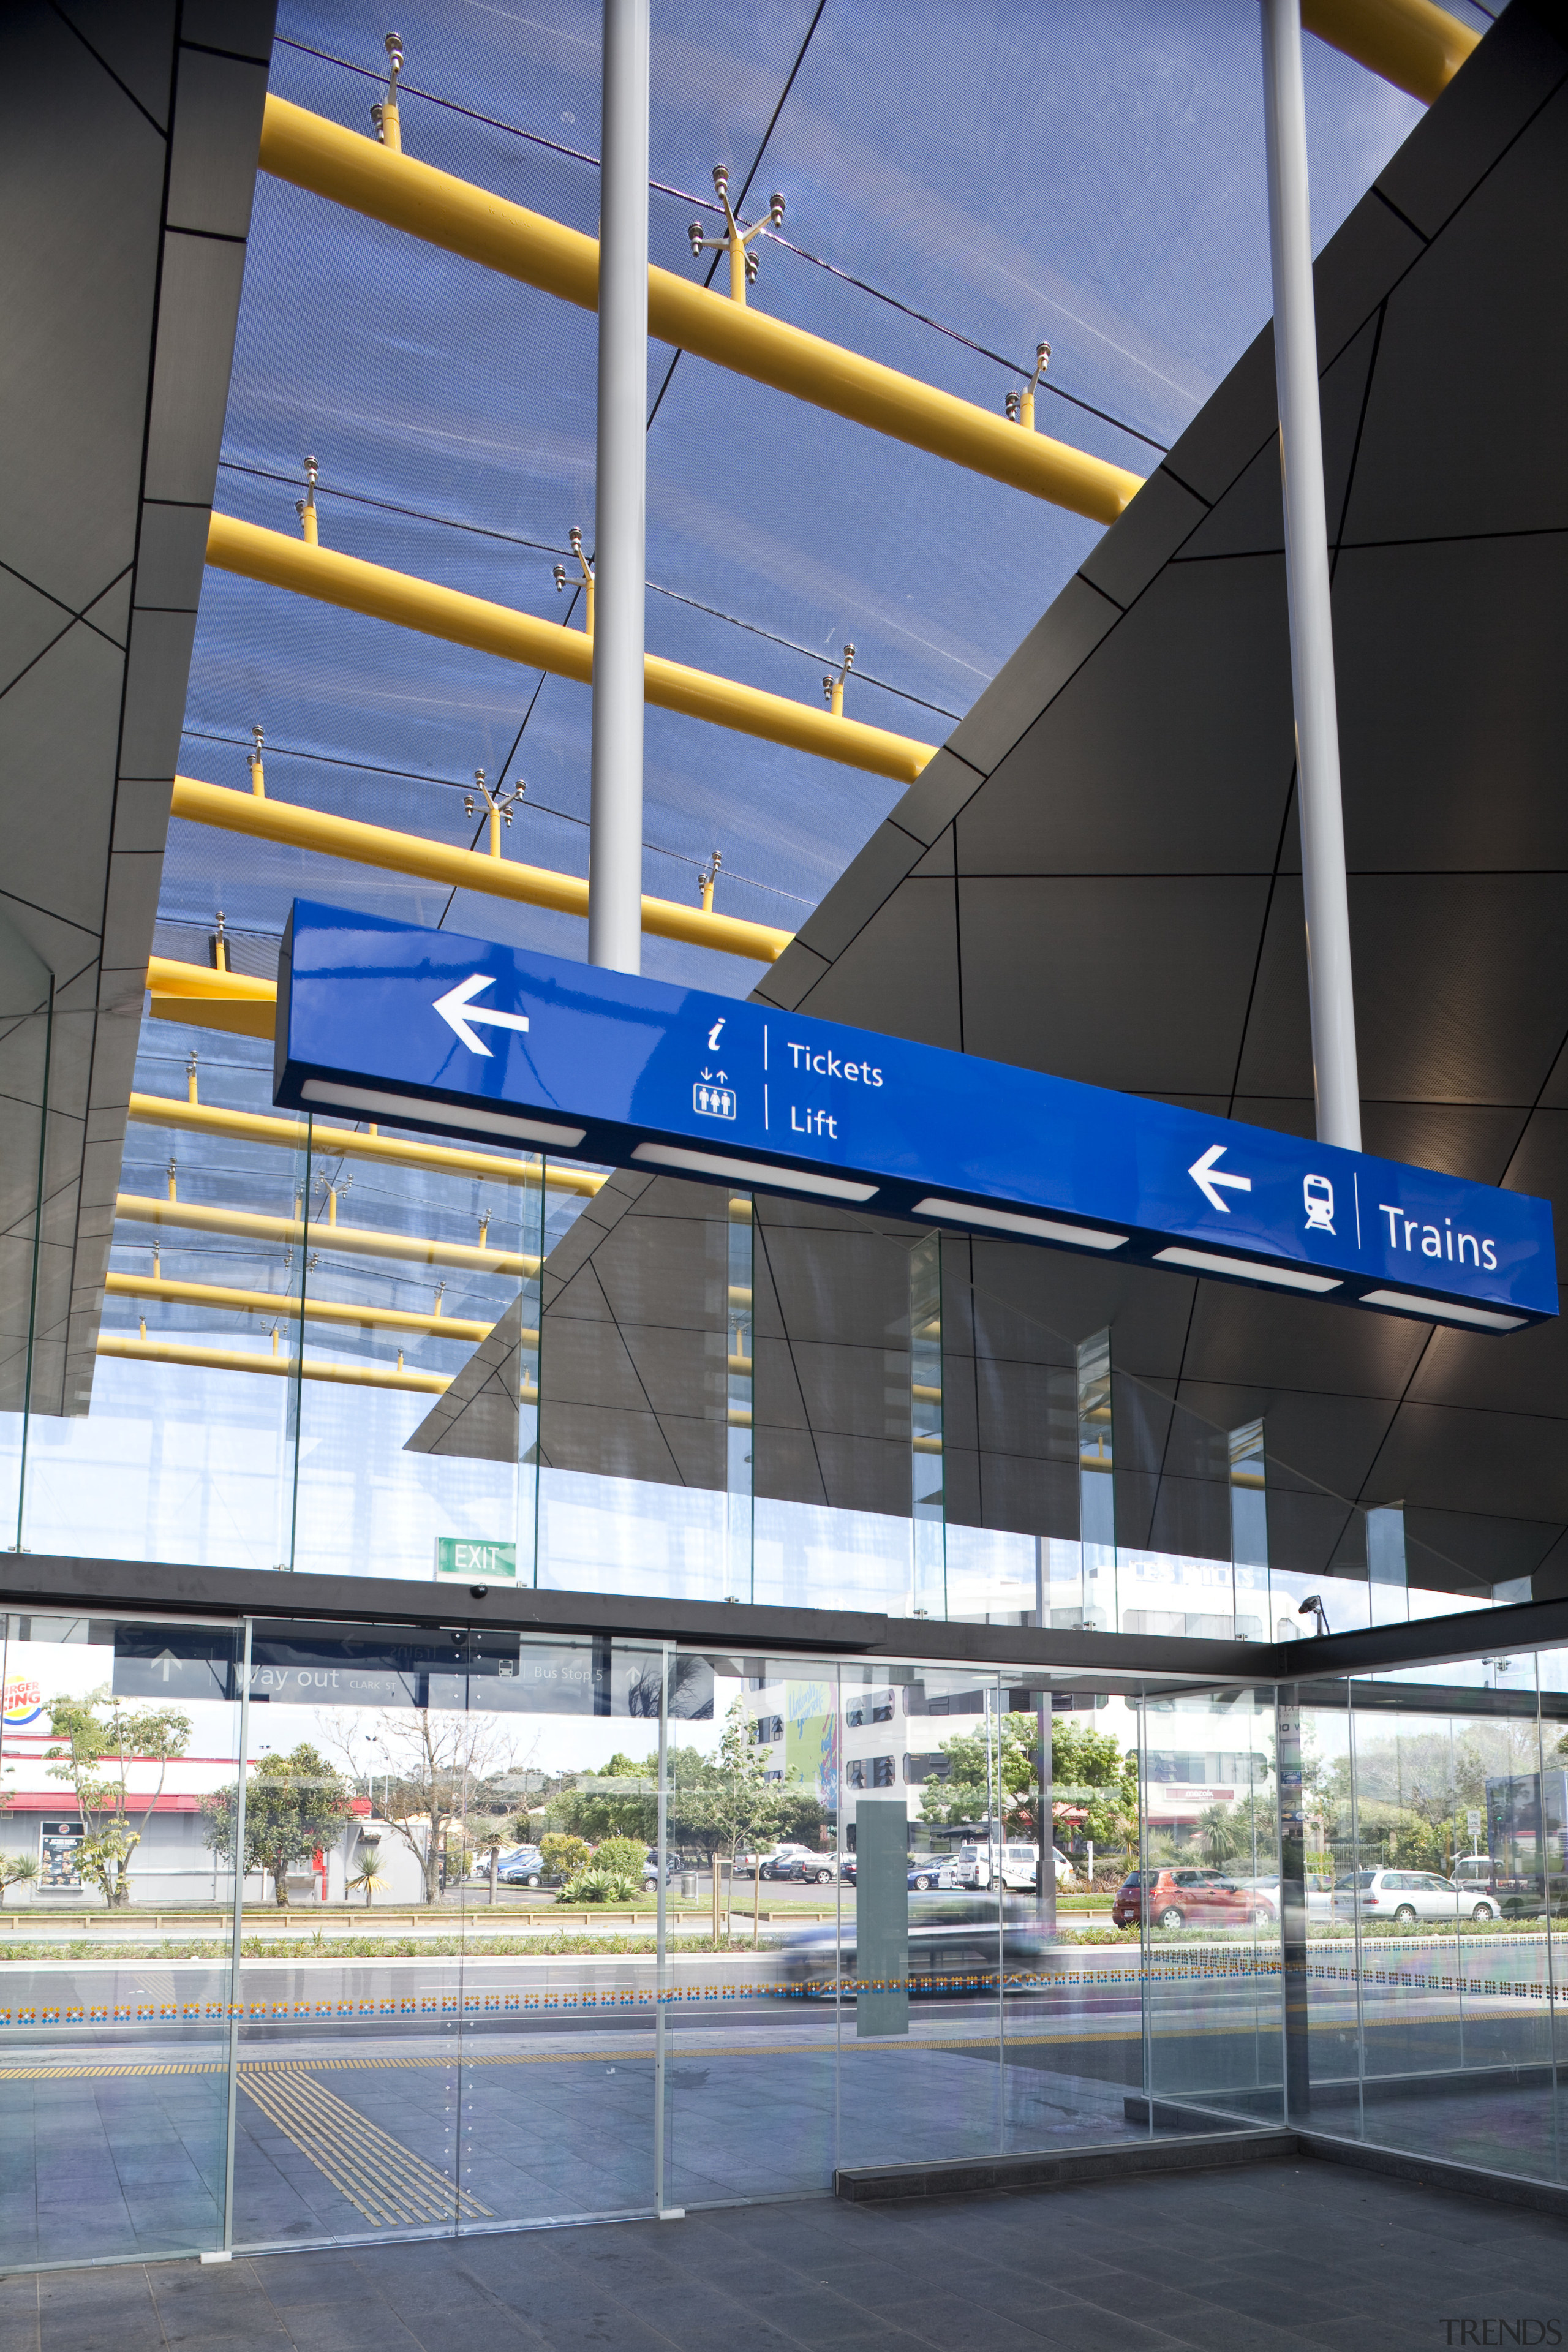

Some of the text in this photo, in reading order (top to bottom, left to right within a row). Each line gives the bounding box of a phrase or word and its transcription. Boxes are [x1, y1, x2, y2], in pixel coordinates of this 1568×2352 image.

[787, 1042, 883, 1087] Tickets
[791, 1106, 838, 1139] Lift
[1379, 1204, 1498, 1270] Trains
[454, 1544, 500, 1570] EXIT
[297, 1670, 339, 1688] out
[349, 1680, 380, 1690] CLARK
[385, 1681, 396, 1691] ST
[535, 1666, 603, 1683] Bus Stop 5
